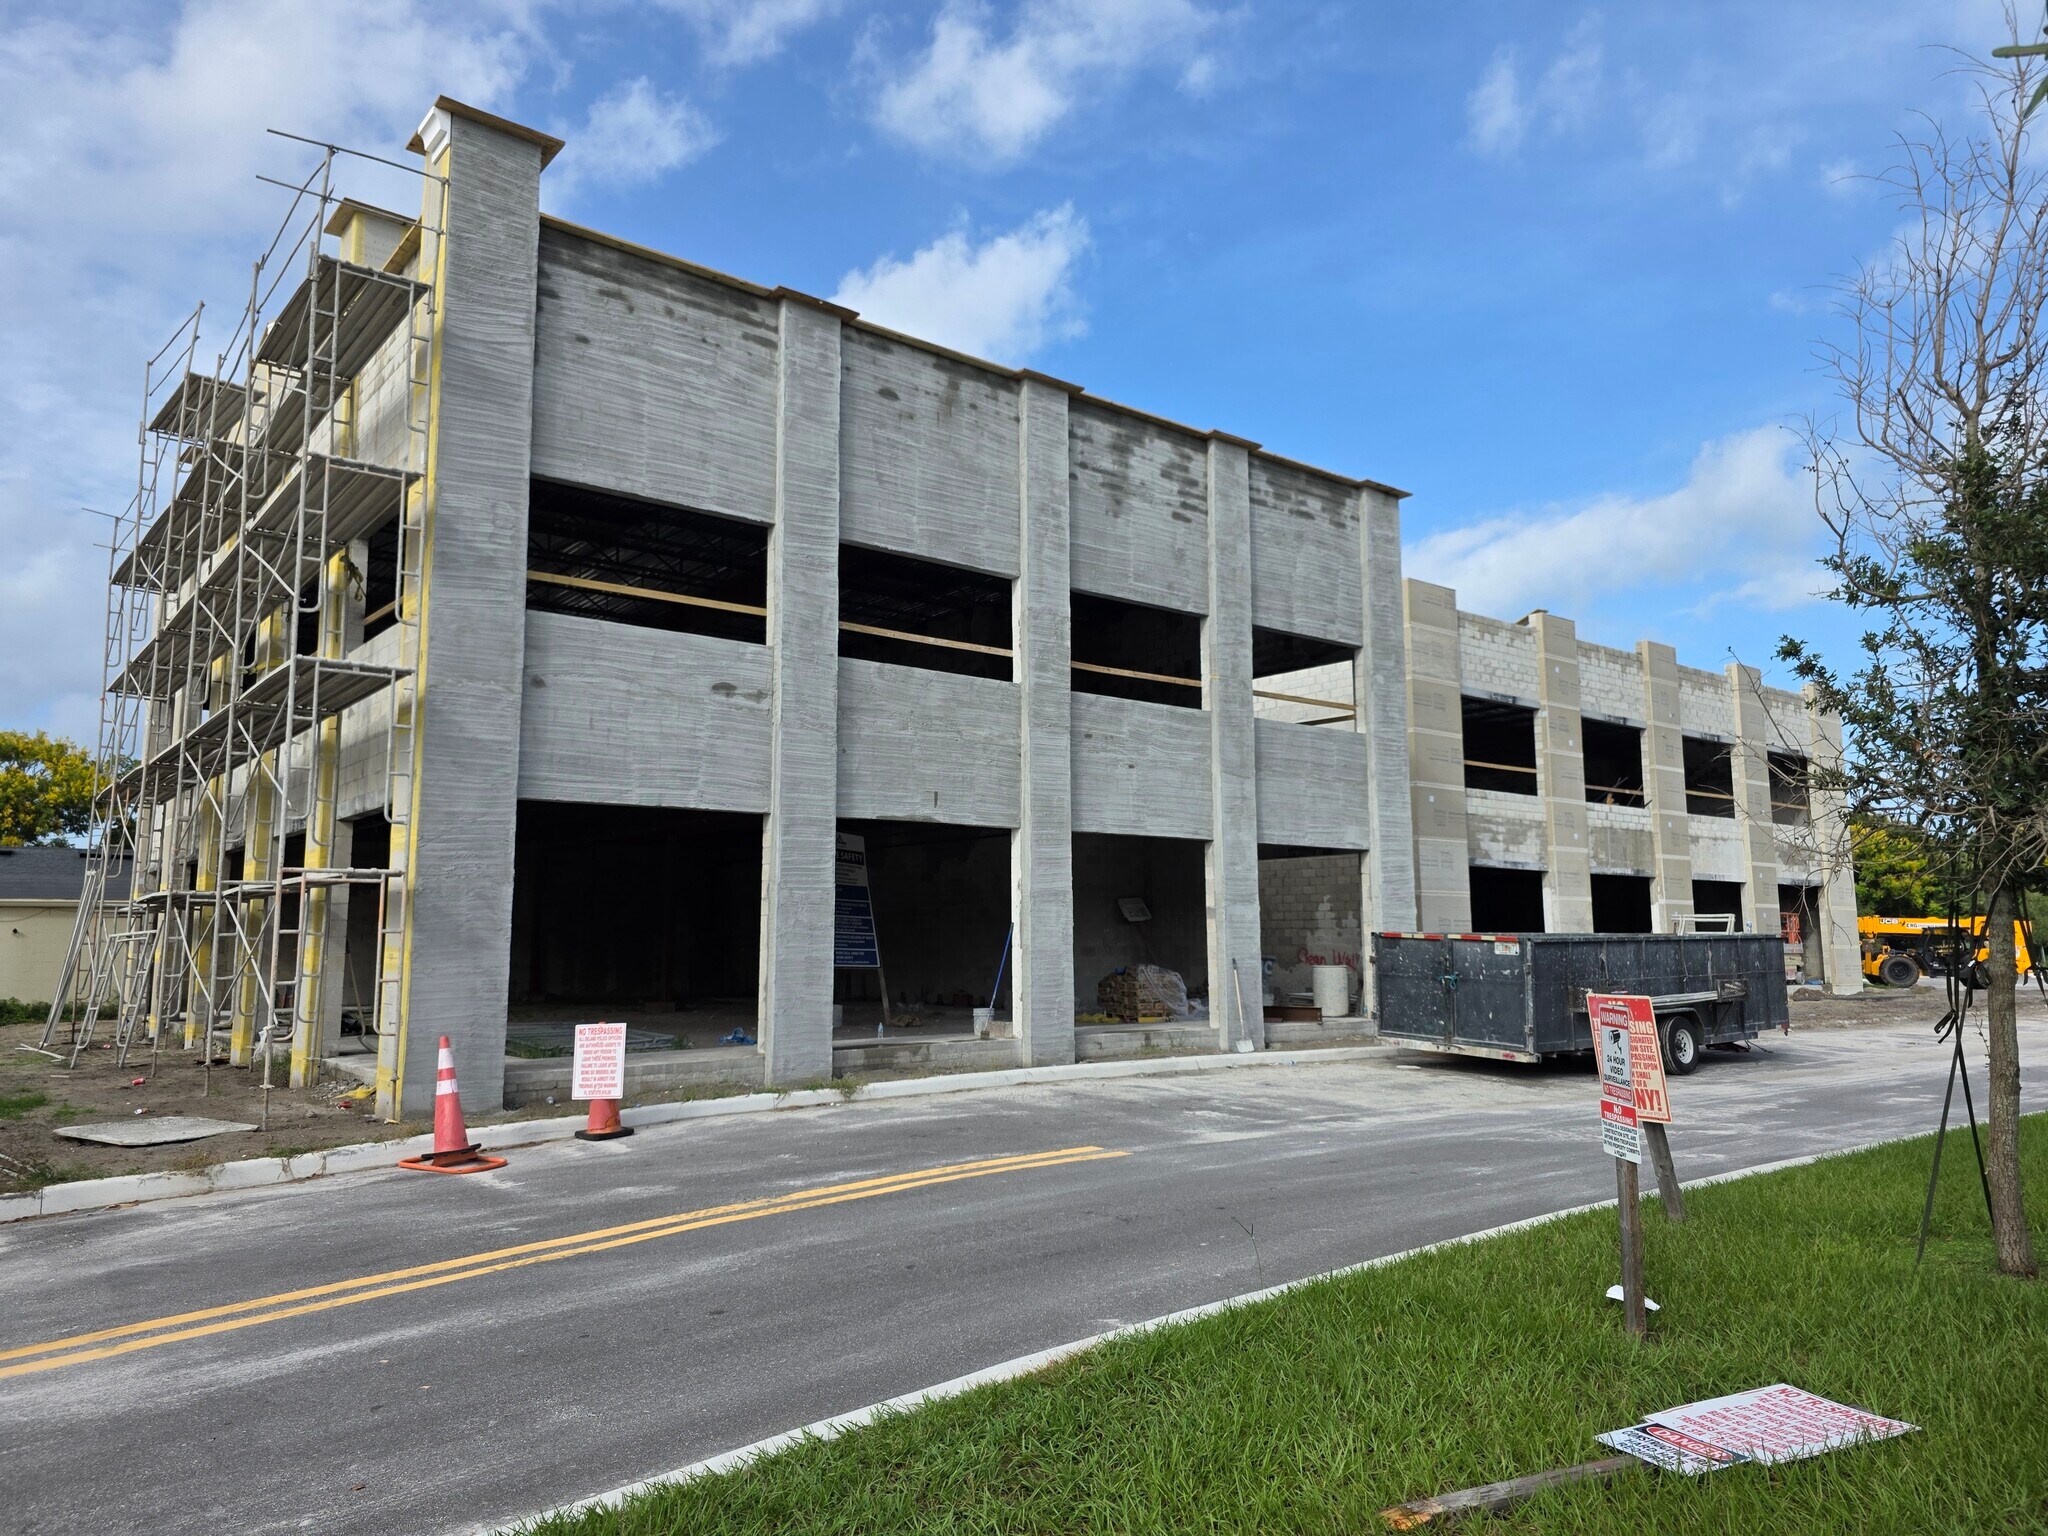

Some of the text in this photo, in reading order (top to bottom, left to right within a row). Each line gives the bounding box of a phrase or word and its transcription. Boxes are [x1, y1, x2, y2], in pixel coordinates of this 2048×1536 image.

[840, 851, 862, 863] SAFETY
[1297, 947, 1326, 966] Clean
[1601, 1010, 1628, 1026] WARNING
[579, 1026, 622, 1036] NO TRESPASSING
[1630, 1020, 1654, 1034] SING
[1606, 1054, 1626, 1066] 24 HOUR
[1644, 1062, 1658, 1070] UPON
[1610, 1065, 1624, 1076] VIDEO
[1636, 1071, 1652, 1080] SHALL
[1604, 1074, 1630, 1088] SURVEILLANCE
[1604, 1084, 1632, 1100] NO TRESPASSING
[1634, 1088, 1662, 1112] NY!
[1614, 1104, 1622, 1115] NO
[1604, 1110, 1634, 1126] TRESPASSING
[1604, 1126, 1622, 1137] CONSTRUCTION
[1620, 1125, 1638, 1135] DESIGNATED
[1612, 1142, 1626, 1151] PROPERTY
[1775, 1388, 1802, 1398] NO
[1799, 1396, 1905, 1431] TRESPASSING
[1622, 1431, 1691, 1457] CONSTRUCTION
[1651, 1430, 1731, 1458] DANGER
